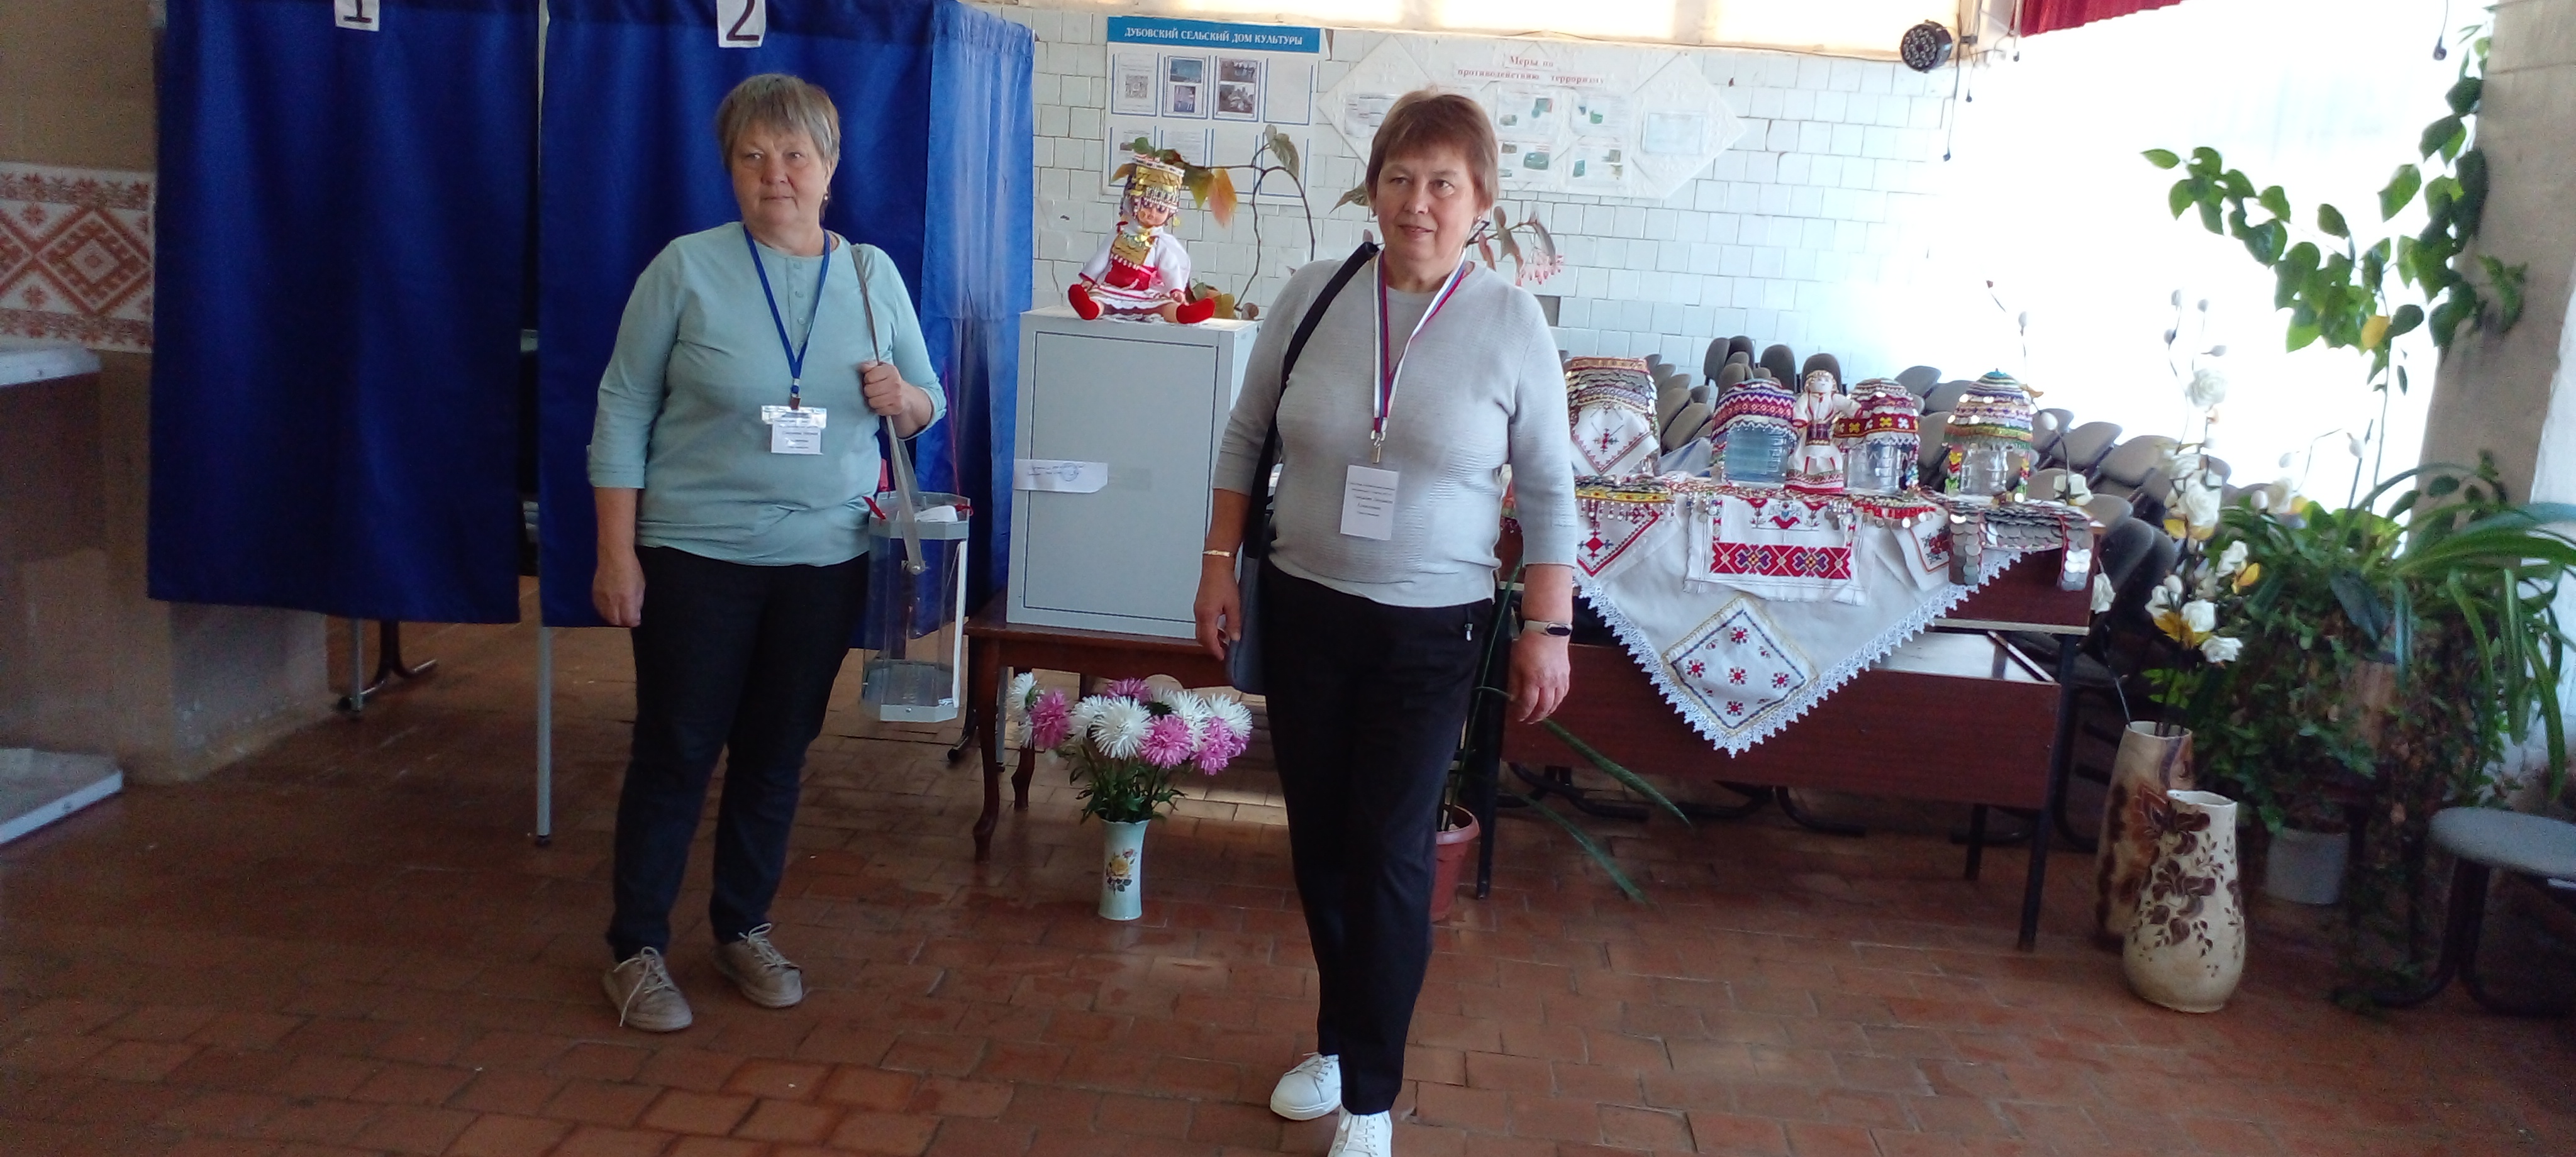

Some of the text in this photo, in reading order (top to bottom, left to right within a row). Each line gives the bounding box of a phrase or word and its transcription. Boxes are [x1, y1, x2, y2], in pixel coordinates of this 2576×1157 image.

[726, 0, 760, 41] 2
[1124, 26, 1303, 45] ДУБОВСКИЙ СЕЛЬСКИЙ ДОМ КУЛЬТУРЫ
[1509, 55, 1538, 67] Меры
[1458, 69, 1604, 84] противодействию терроризму
